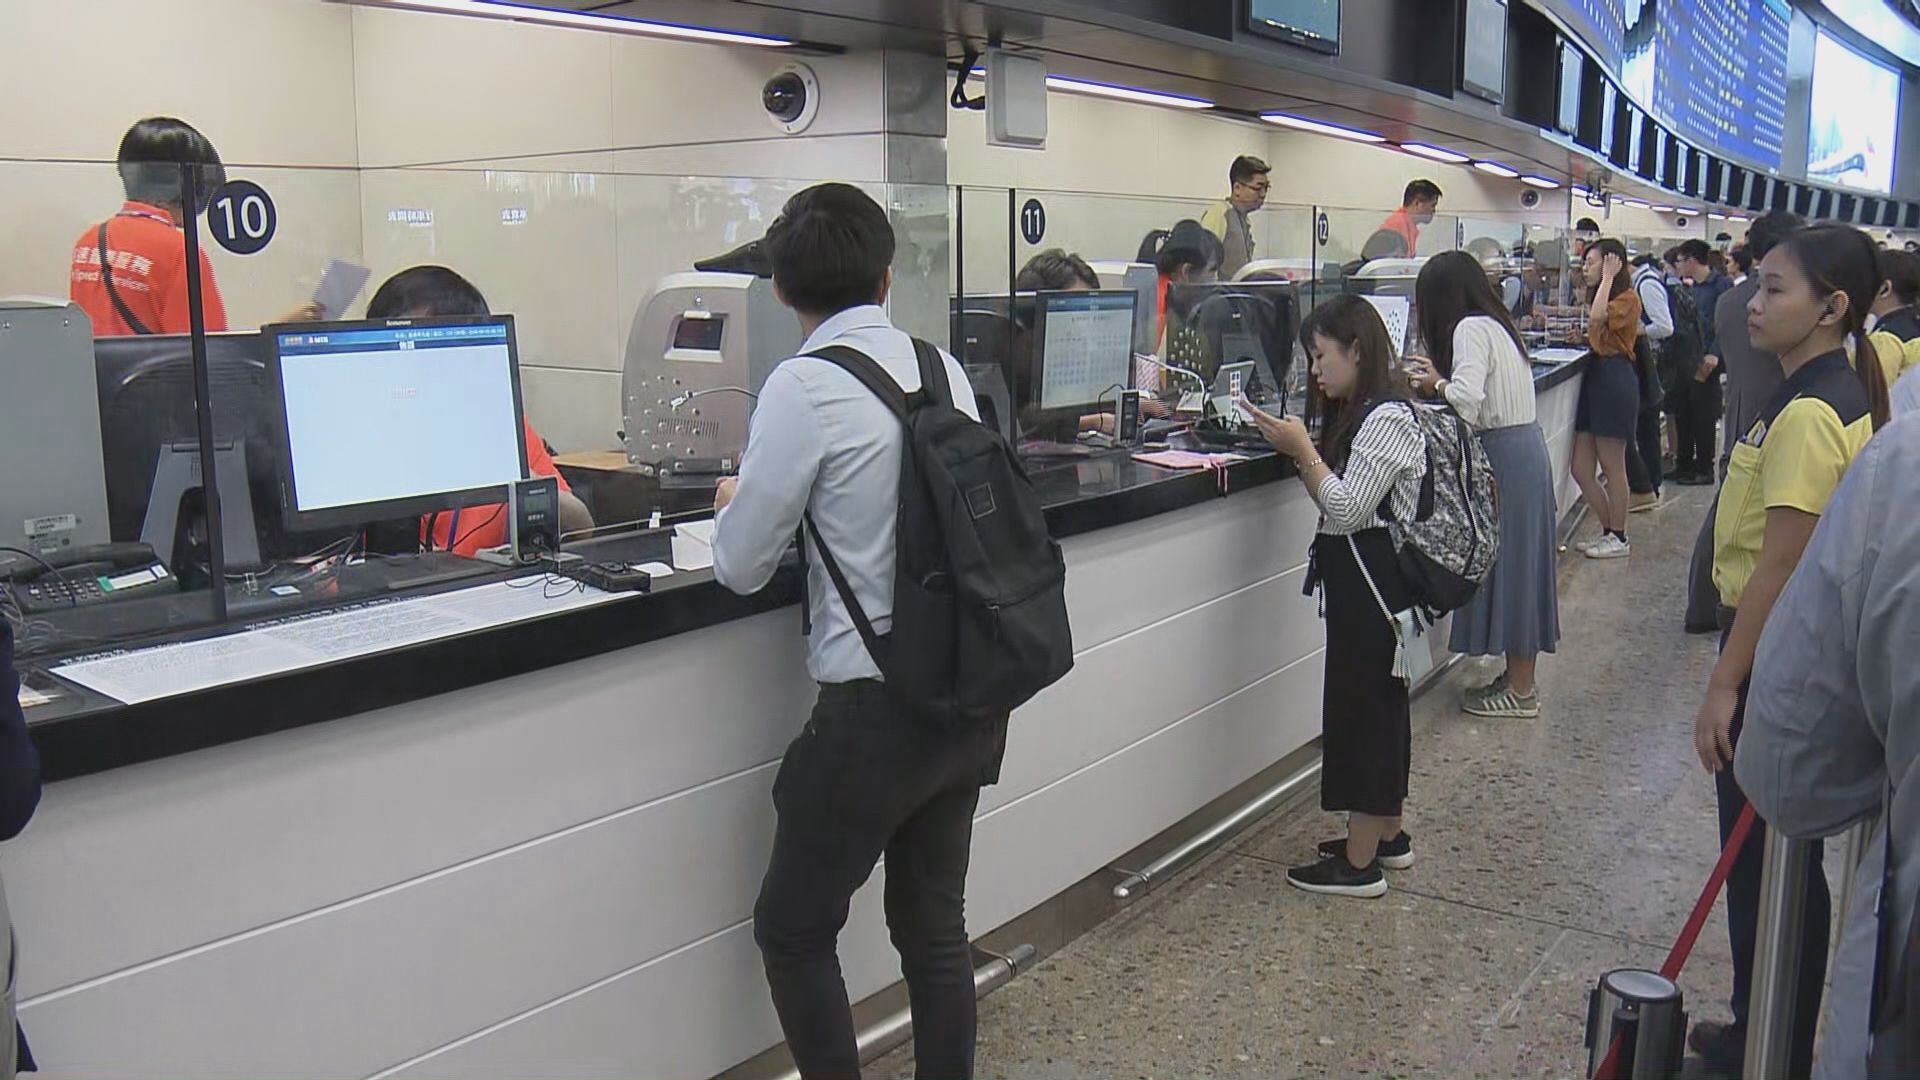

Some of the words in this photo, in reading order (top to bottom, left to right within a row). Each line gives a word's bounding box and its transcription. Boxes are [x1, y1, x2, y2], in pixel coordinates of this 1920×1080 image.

[217, 195, 268, 240] 10
[1025, 208, 1040, 236] 11
[1319, 219, 1328, 240] 12
